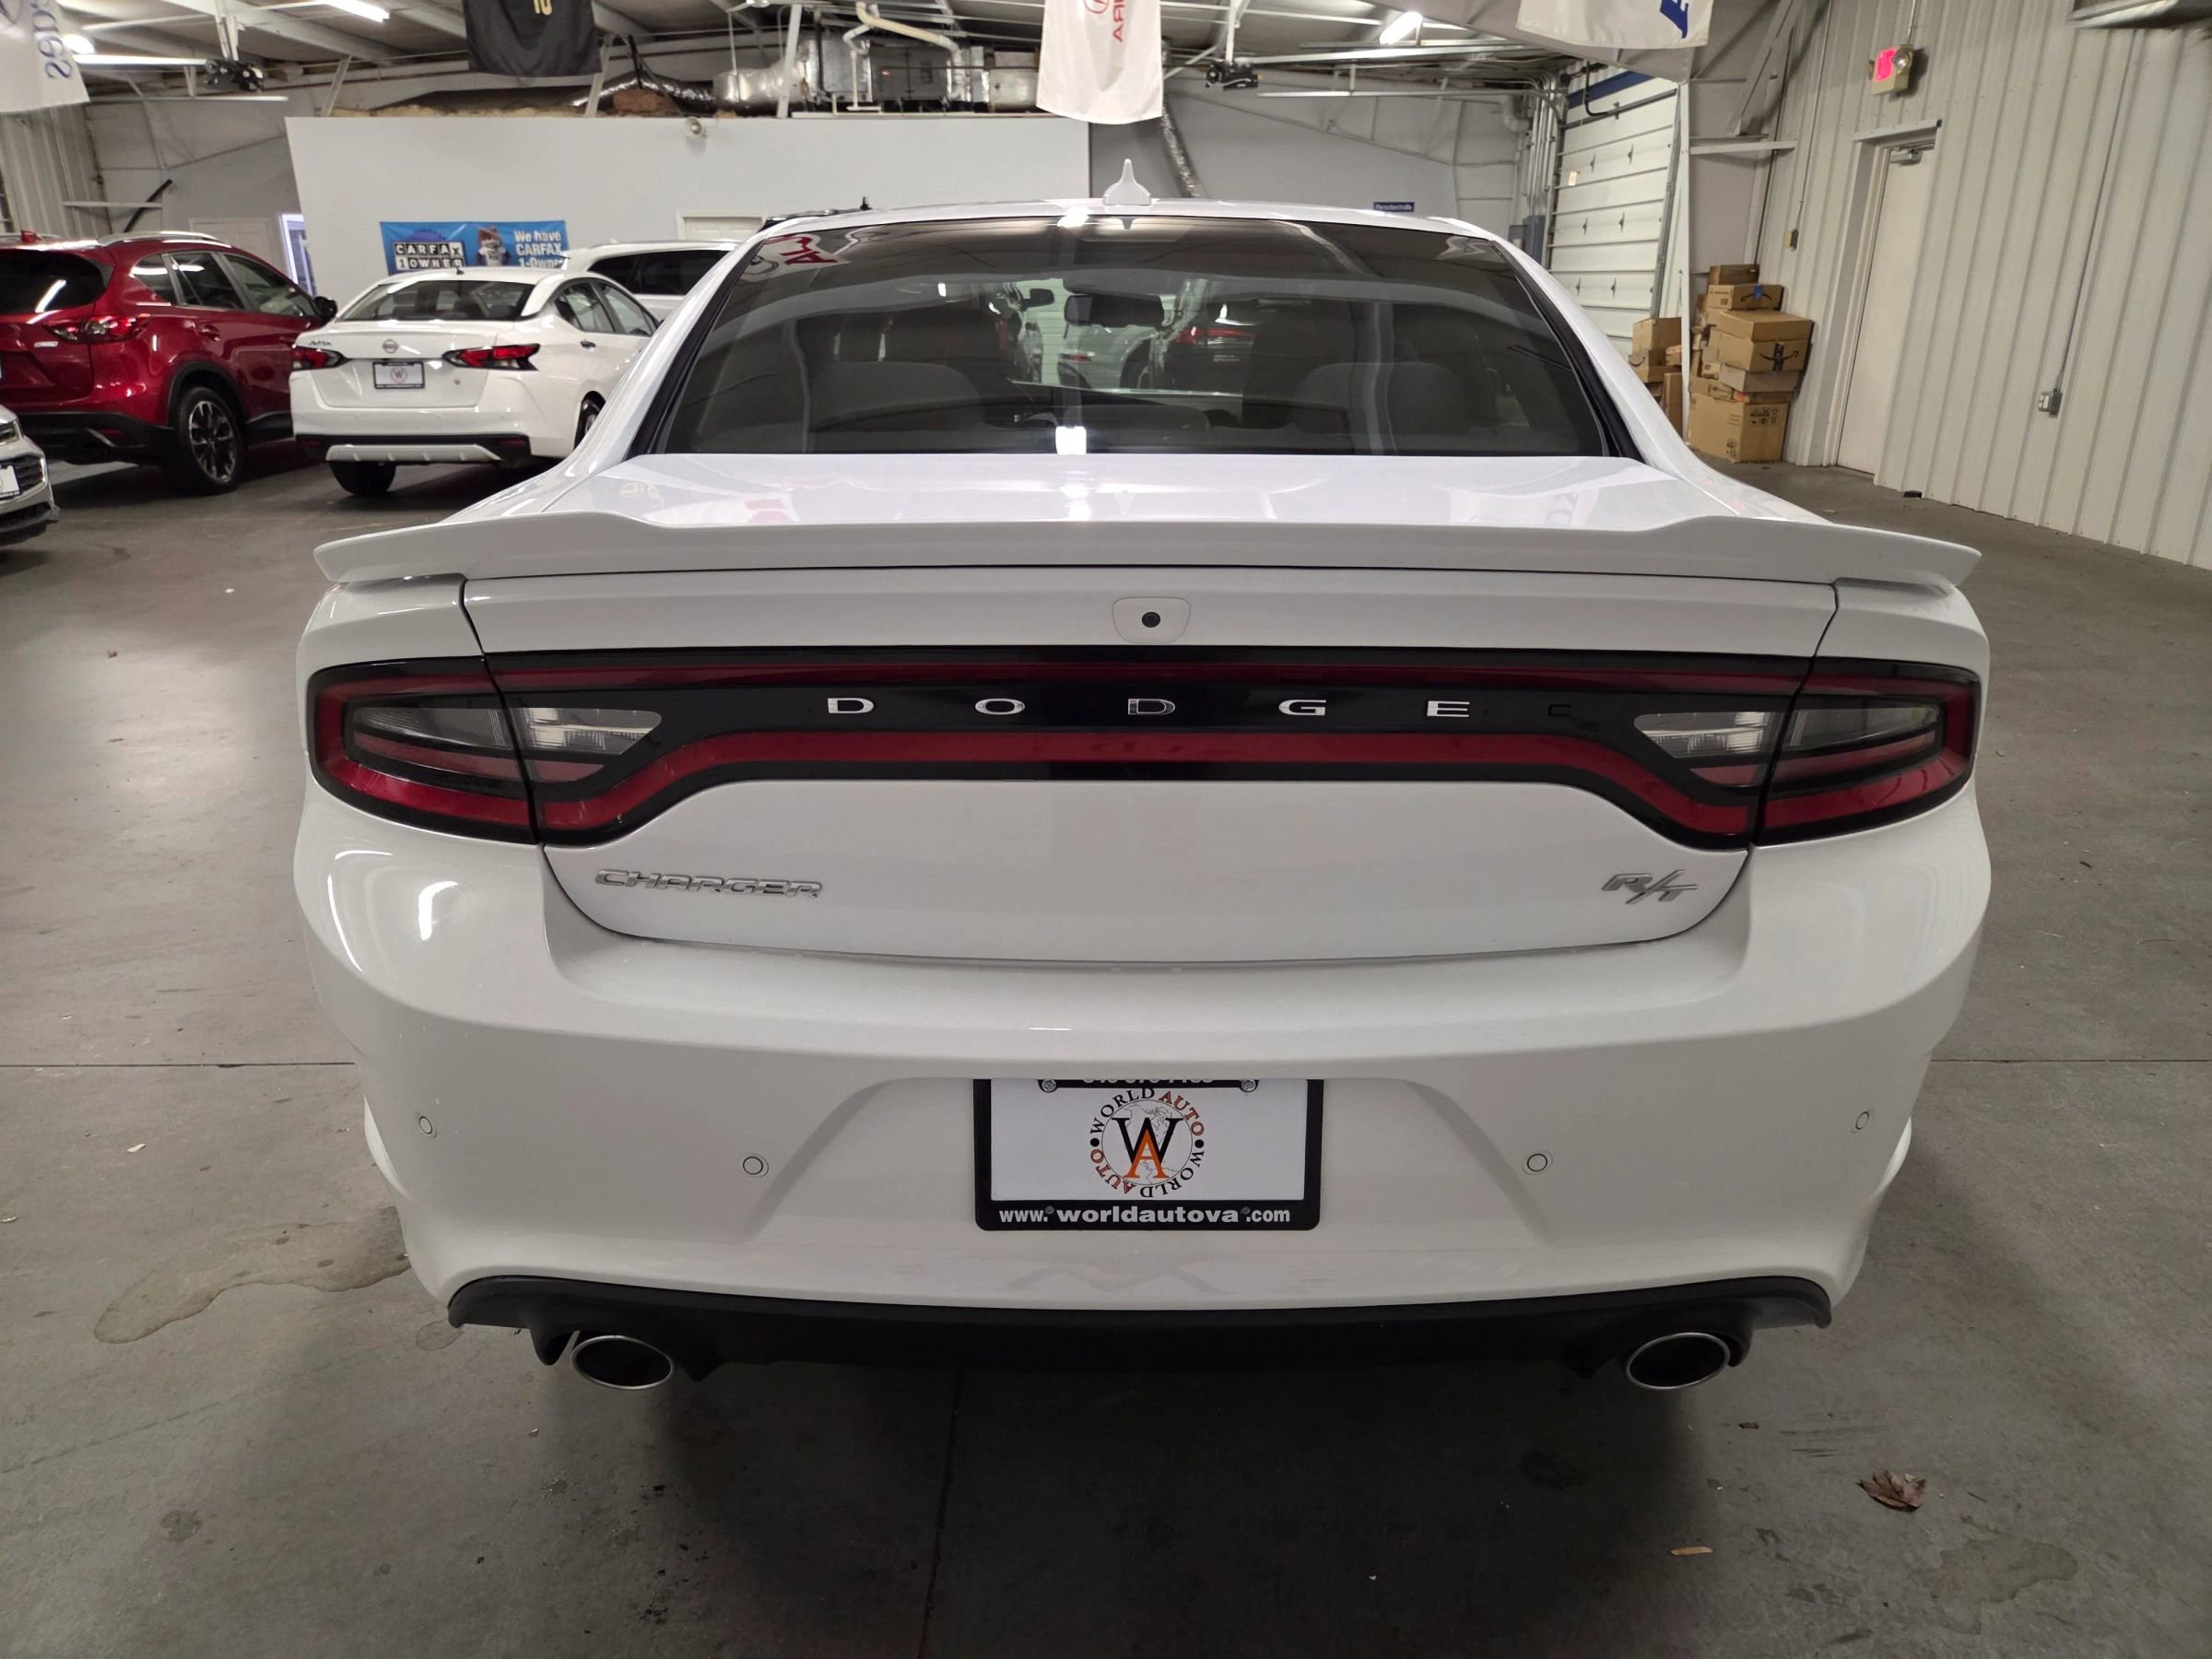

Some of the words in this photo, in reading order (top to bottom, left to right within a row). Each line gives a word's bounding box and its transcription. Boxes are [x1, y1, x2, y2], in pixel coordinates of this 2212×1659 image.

[395, 243, 461, 256] CARFAX
[514, 230, 532, 241] We
[534, 230, 561, 241] have
[516, 242, 562, 256] CARFAX
[827, 698, 1470, 718] DODGE
[595, 869, 823, 898] CHARGER
[1601, 868, 1700, 904] R/T
[1089, 1088, 1155, 1135] WORLD
[1159, 1090, 1205, 1136] AUTO
[1090, 1148, 1137, 1194] AUTO
[1139, 1150, 1206, 1198] WORLD
